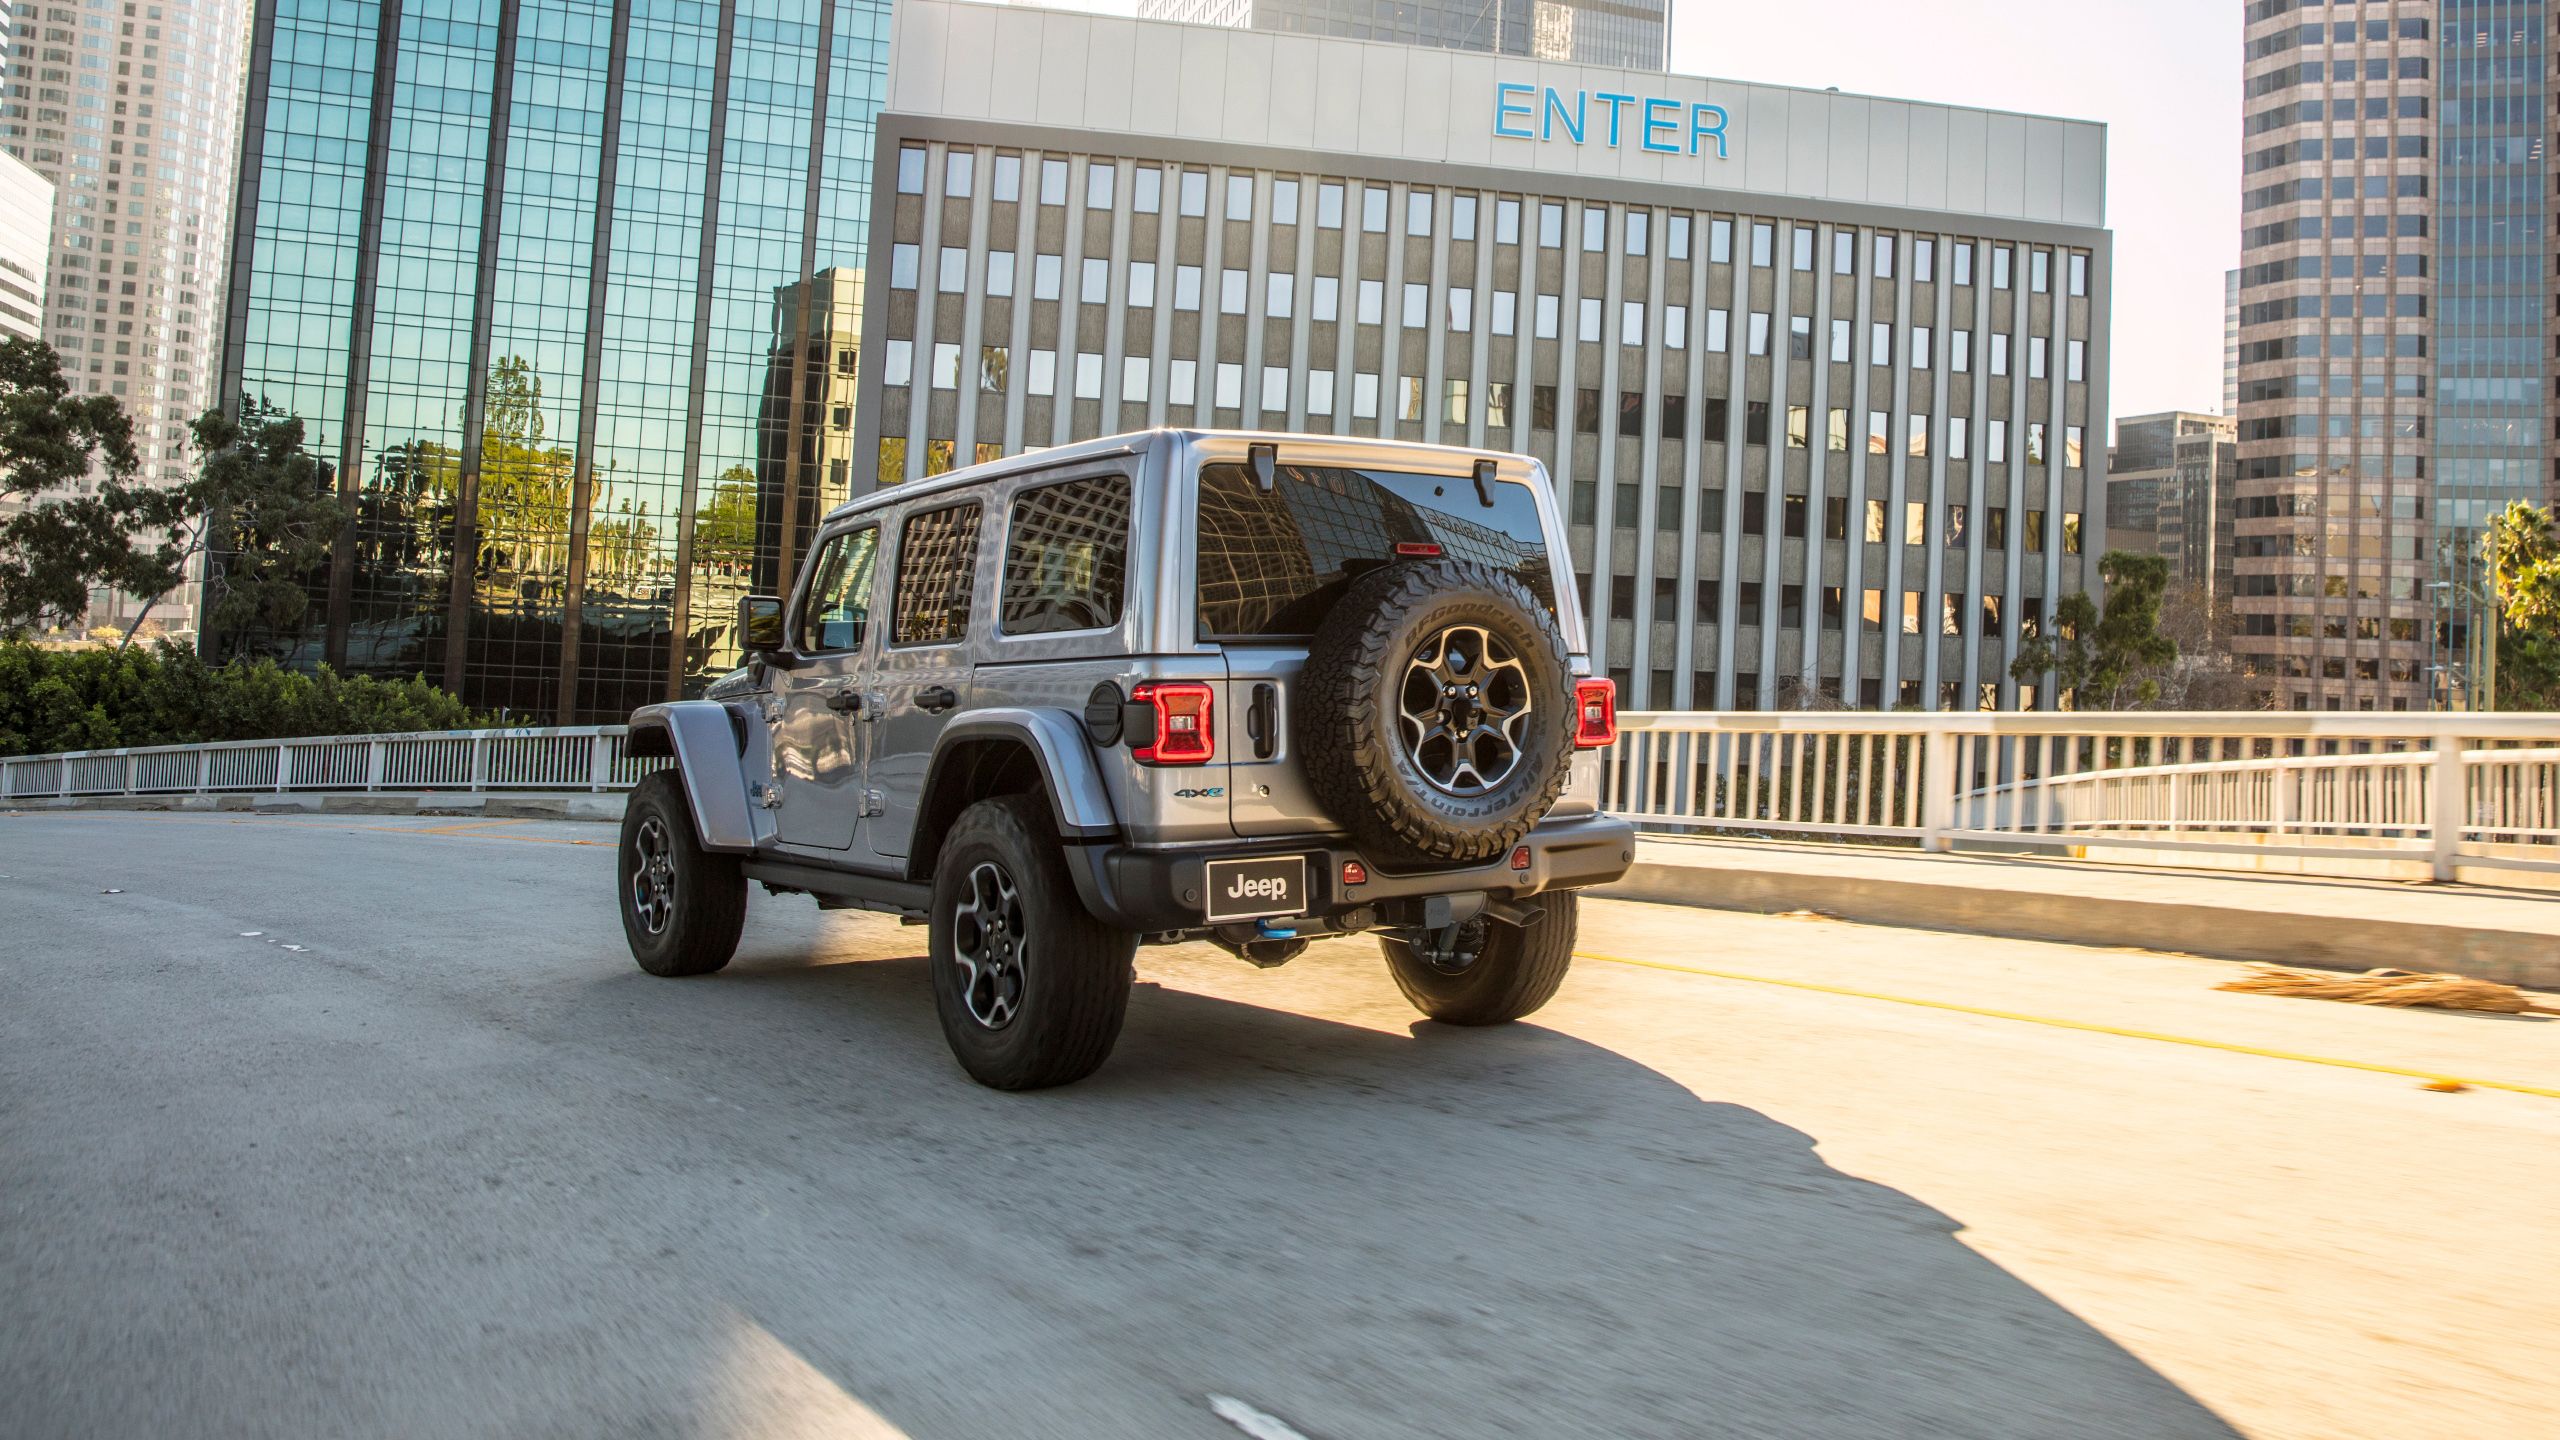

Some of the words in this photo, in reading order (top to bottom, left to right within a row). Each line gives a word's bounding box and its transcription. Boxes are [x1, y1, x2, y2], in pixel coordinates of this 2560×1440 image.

[1494, 82, 1729, 159] ENTER
[1405, 602, 1535, 648] BFGoodrich
[1397, 760, 1427, 801] T/A
[1430, 752, 1543, 817] All-Terrain
[1228, 874, 1287, 900] Jeep
